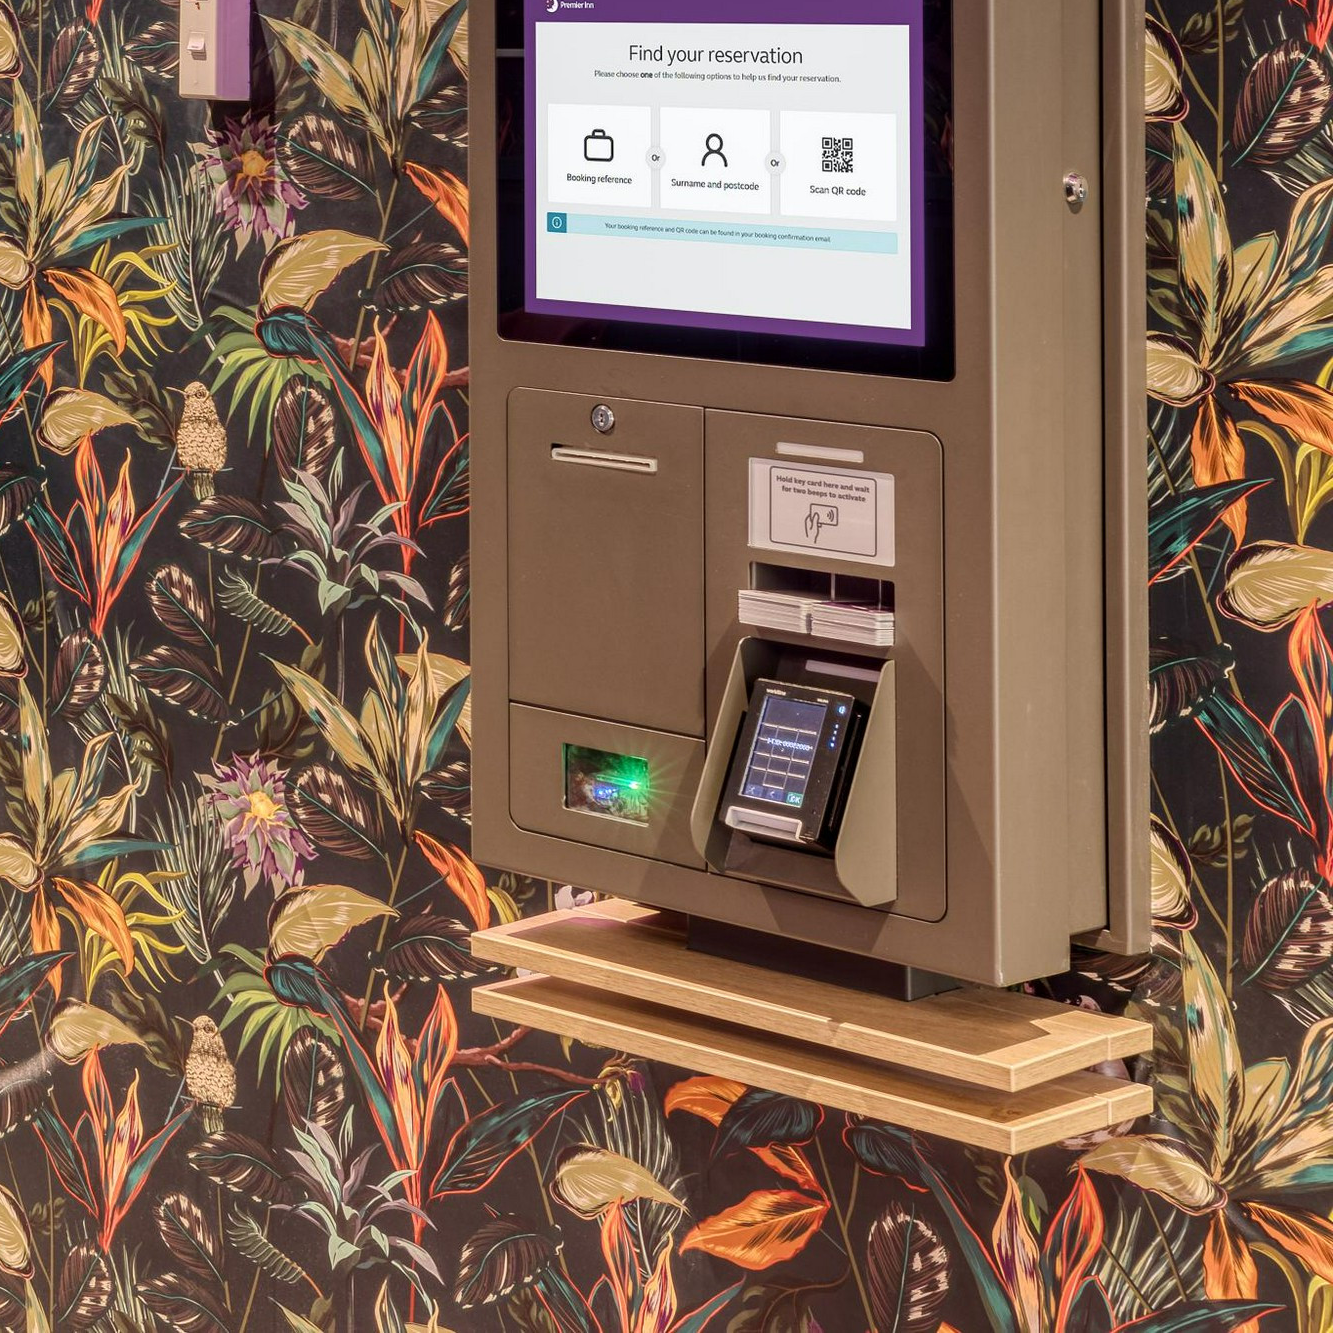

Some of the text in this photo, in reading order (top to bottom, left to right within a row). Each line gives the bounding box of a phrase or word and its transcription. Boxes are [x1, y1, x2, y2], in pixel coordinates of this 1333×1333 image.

[560, 0, 584, 9] Premier
[629, 45, 802, 66] Find your reservation
[674, 72, 705, 80] following
[741, 73, 757, 82] help
[651, 154, 660, 162] Or
[770, 159, 780, 167] Or
[567, 173, 632, 184] Booking reference
[671, 179, 705, 187] Surname
[723, 182, 759, 190] postcode
[809, 185, 866, 196] Scan QR code
[776, 475, 792, 484] Hold
[794, 478, 806, 486] key
[823, 481, 839, 489] here
[807, 489, 827, 498] beeps
[838, 493, 866, 502] activate
